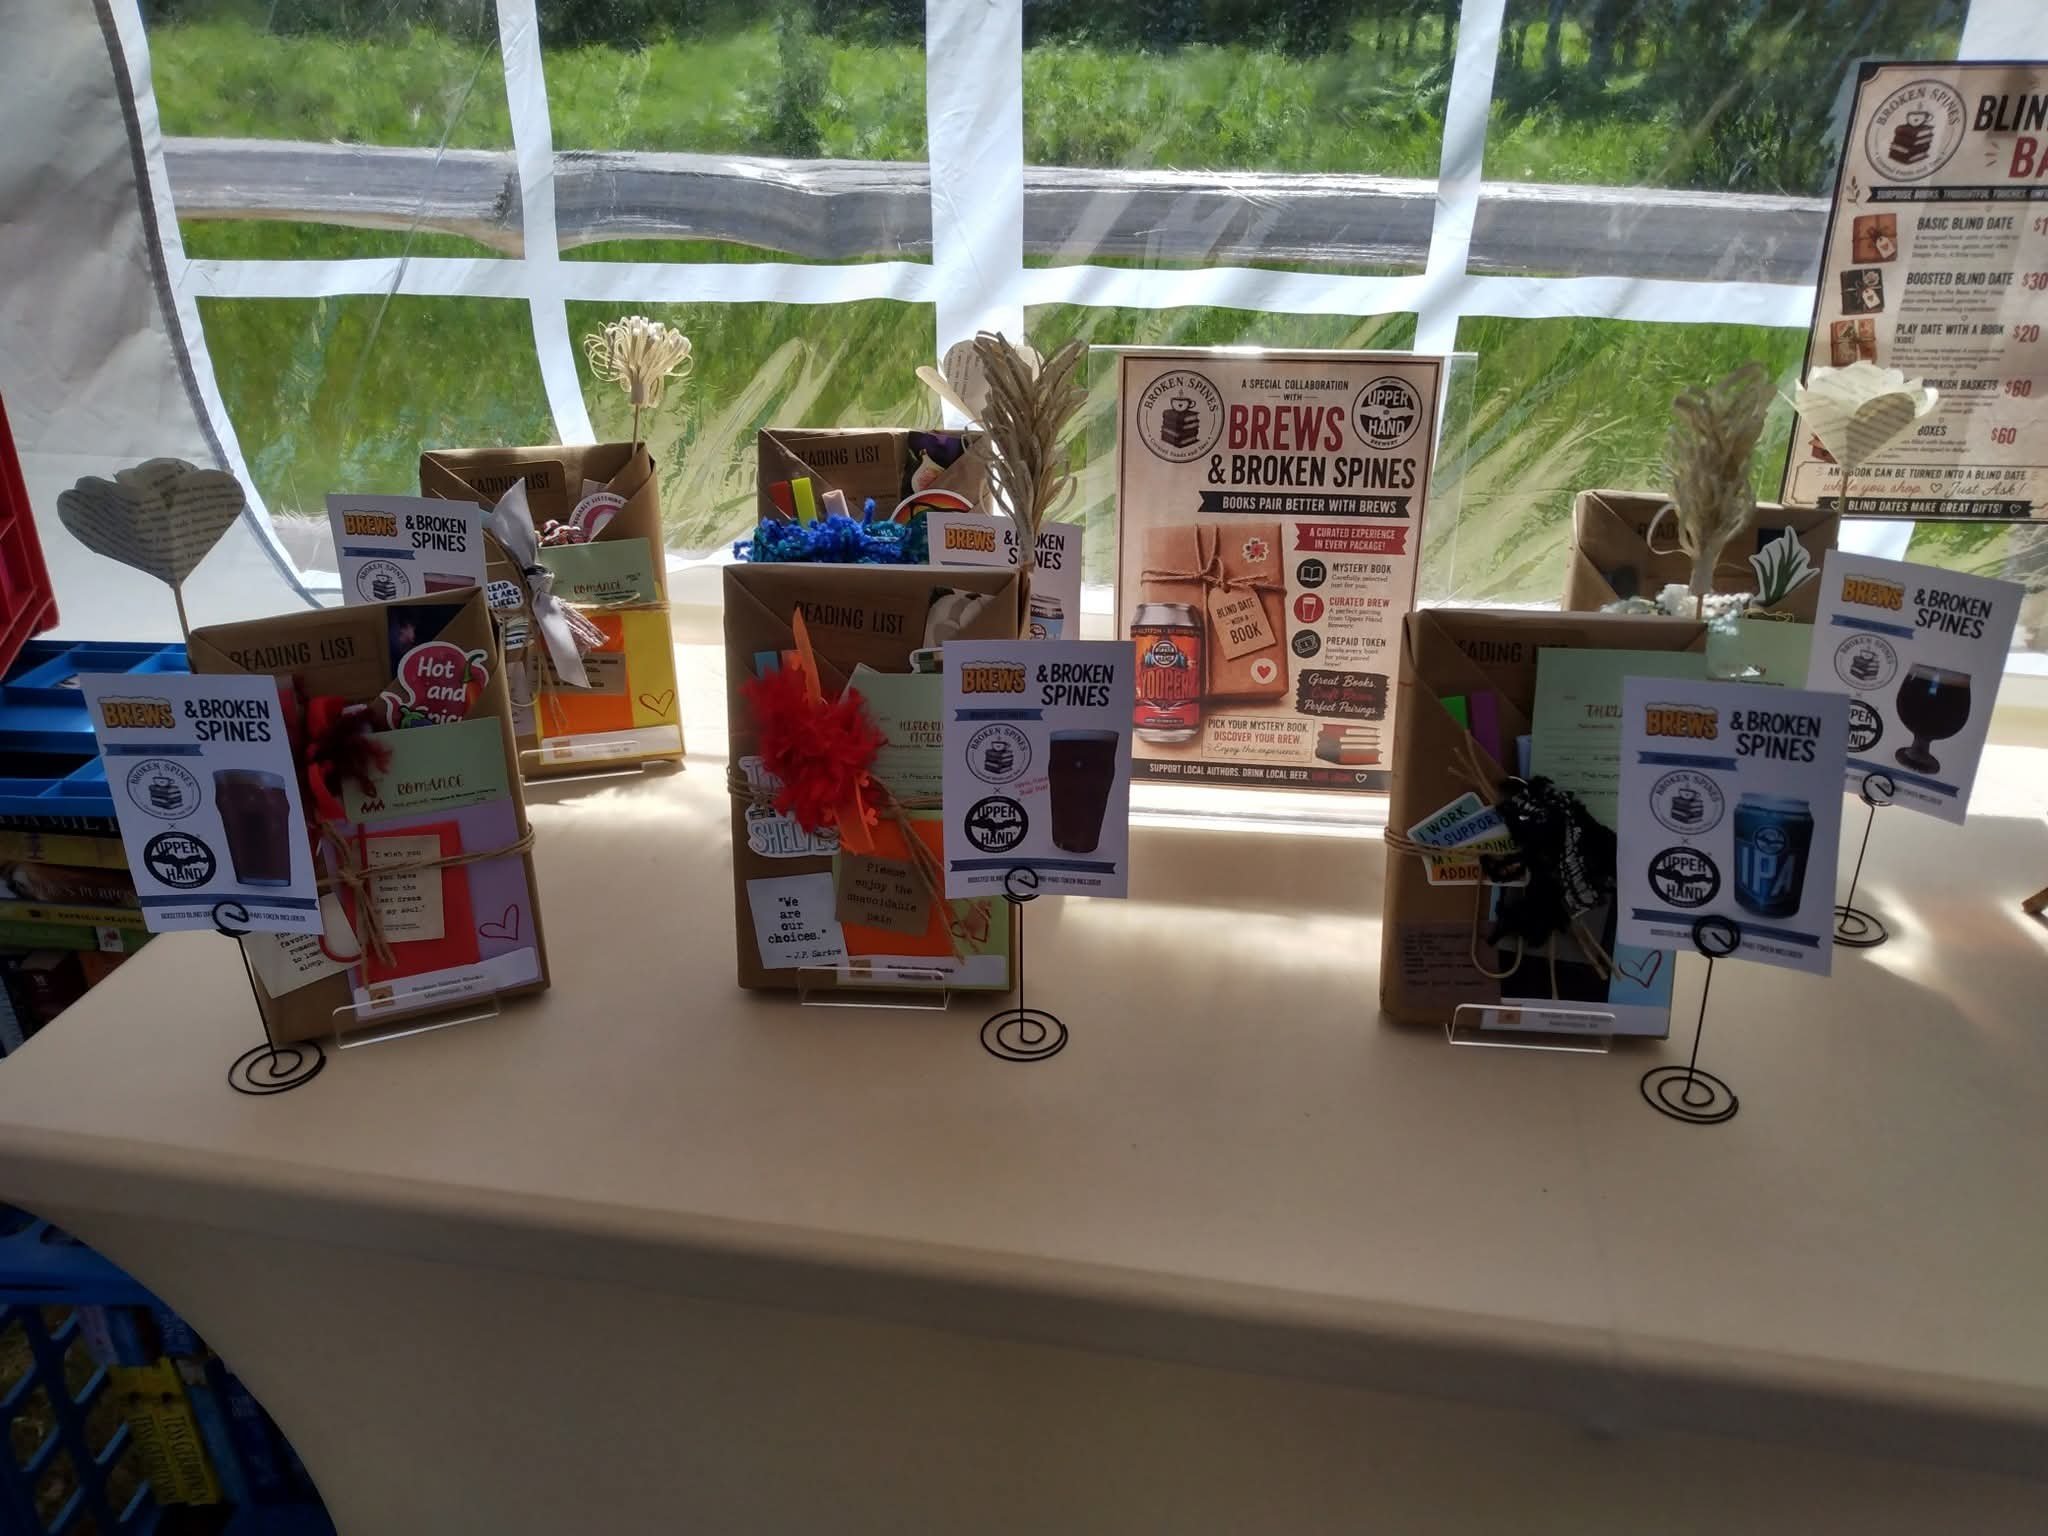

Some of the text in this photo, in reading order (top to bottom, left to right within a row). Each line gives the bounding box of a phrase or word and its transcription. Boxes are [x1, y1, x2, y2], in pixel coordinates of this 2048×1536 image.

[1876, 87, 1961, 126] BROKEN SPINES
[1917, 217, 1948, 230] BASIC
[1951, 217, 1983, 230] BLIND
[1986, 217, 2014, 230] DATE
[1906, 272, 2048, 291] BOOSTED BLIND DATE $30
[1896, 324, 2040, 343] PLAY DATE WITH A BOOK $20
[1144, 376, 1219, 413] BROKEN SPINES
[1241, 380, 1349, 391] A SPECIAL COLLABORATION
[1959, 379, 2032, 397] BASKETS $60
[1283, 392, 1302, 401] WITH
[1367, 389, 1409, 436] UPPER HAND
[1228, 404, 1345, 452] BREWS
[1990, 427, 2017, 445] $60
[855, 445, 881, 464] LIST
[1207, 454, 1416, 489] & BROKEN SPINES
[1874, 468, 2026, 481] CAN BE TURNED INTO A BLIND DATE
[1860, 480, 2024, 497] you shop Just Ask!
[1222, 496, 1396, 514] BOOKS PAIR BETTER WITH BREWS
[1848, 501, 2002, 514] BLIND DATES MAKE GREAT GIFTS!
[343, 511, 467, 537] BREWS & BROKEN
[1309, 527, 1396, 540] A CURATED EXPERIENCE
[411, 532, 466, 553] SPINES
[945, 526, 1014, 552] BREWS &
[1314, 540, 1386, 551] IN EVERY PACKAGE!
[359, 562, 383, 580] BROKEN
[1332, 563, 1392, 574] MYSTERY BOOK
[493, 596, 521, 608] LIKELY
[501, 588, 519, 597] ARE
[1329, 596, 1391, 608] CURATED BREW
[1842, 576, 1992, 619] BREWS & BROKEN
[1216, 598, 1256, 619] BLIND DATE
[872, 611, 904, 634] LIST
[1915, 608, 1985, 640] SPINES
[1229, 626, 1263, 645] BOOK
[1326, 636, 1386, 647] PREPAID TOKEN
[320, 637, 355, 662] LIST
[1841, 636, 1873, 655] BROKEN
[416, 656, 455, 679] Hot
[962, 664, 1114, 694] BREWS & BROKEN
[1308, 672, 1377, 688] Great Books.
[427, 685, 467, 702] and
[1041, 685, 1111, 707] SPINES
[102, 699, 270, 729] BREWS & BROKEN
[1304, 699, 1378, 718] Perfect Pairings.
[195, 722, 271, 742] SPINES
[1208, 719, 1309, 732] PICK YOUR MYSTERY BOOK.
[1646, 709, 1821, 740] BREWS & BROKEN
[971, 727, 1027, 752] BROKEN SPINES
[1214, 731, 1301, 745] DISCOVER YOUR BREW.
[1736, 733, 1816, 763] SPINES
[131, 762, 195, 788] BROKEN SPINES
[1149, 763, 1182, 774] SUPPORT
[1183, 764, 1206, 775] LOCAL
[1206, 766, 1241, 777] AUTHORS.
[1242, 768, 1264, 778] DRINK
[1265, 769, 1288, 779] LOCAL
[1289, 770, 1309, 780] BEER.
[1655, 774, 1719, 802] BROKEN SPINES
[977, 805, 1017, 845] UPPER HAND
[1427, 805, 1469, 835] WORK
[155, 840, 201, 882] UPPER HAND
[1663, 856, 1707, 901] UPPER HAND
[1740, 846, 1796, 897] IPA
[855, 878, 913, 895] enjoy the
[778, 896, 799, 907] "We
[779, 910, 801, 919] are
[780, 920, 804, 931] our
[767, 929, 827, 944] choices."
